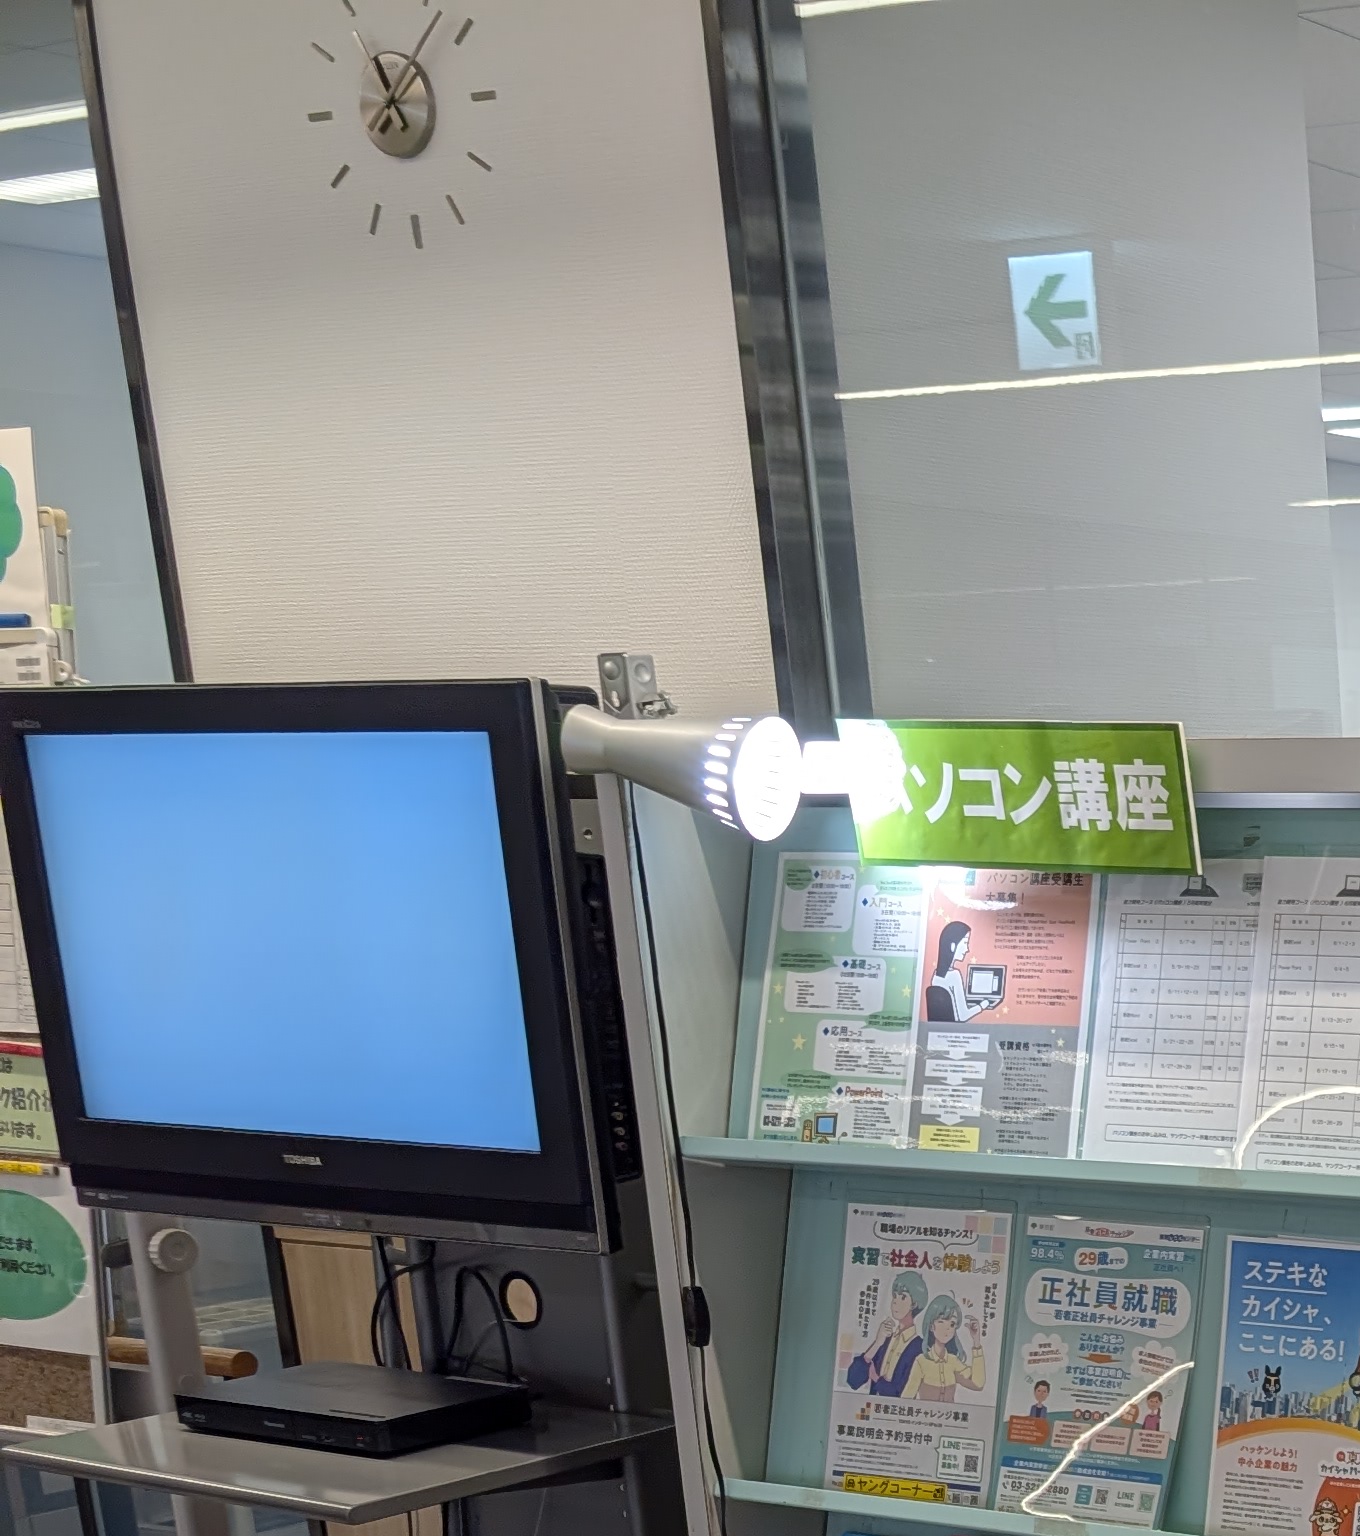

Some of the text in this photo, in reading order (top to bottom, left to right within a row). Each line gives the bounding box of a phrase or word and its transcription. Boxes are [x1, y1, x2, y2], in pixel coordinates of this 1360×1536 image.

[901, 758, 1174, 831] ソコン講座
[851, 1245, 1001, 1275] 実習で社会人を体験しよう
[1244, 1259, 1329, 1287] ステキな
[1037, 1276, 1178, 1316] 正社員就職
[1241, 1294, 1332, 1325] カイシャ、
[1238, 1331, 1345, 1362] ここにある!
